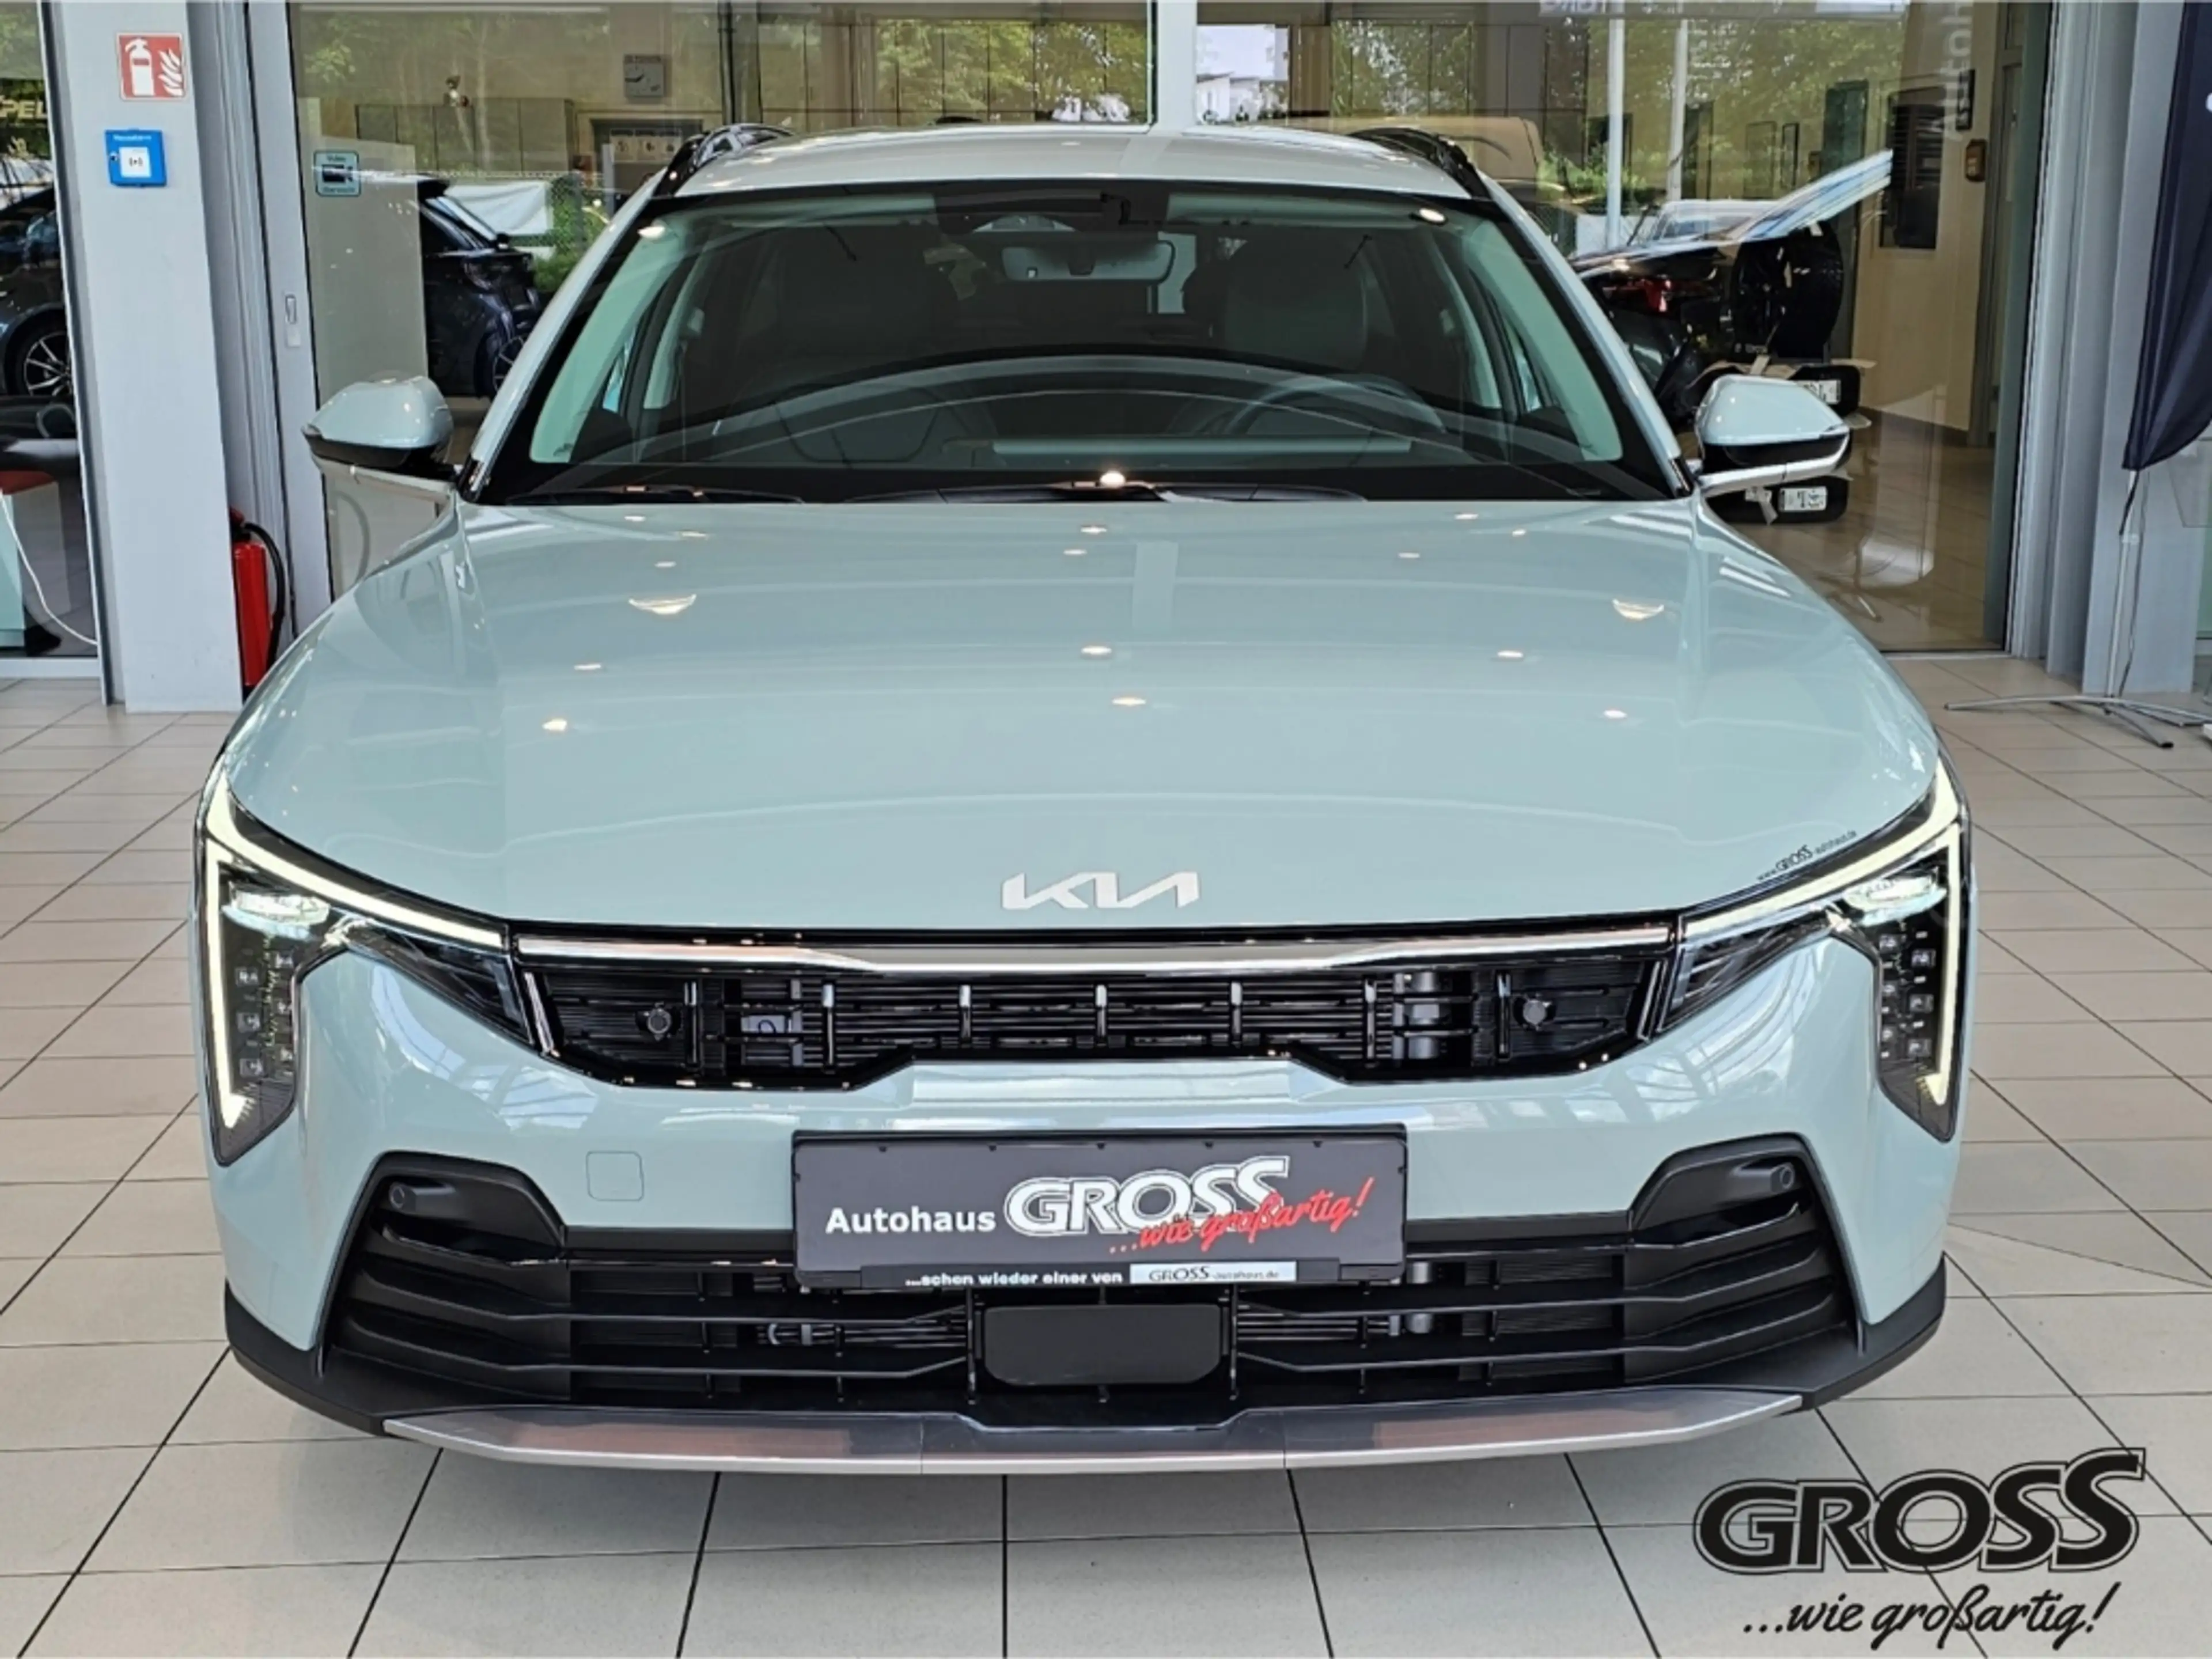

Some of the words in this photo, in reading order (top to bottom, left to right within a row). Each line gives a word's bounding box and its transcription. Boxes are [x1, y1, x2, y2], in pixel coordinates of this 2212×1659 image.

[0, 95, 48, 120] PEL
[1002, 871, 1200, 910] KIA
[825, 1205, 997, 1234] Autohaus
[1003, 1155, 1290, 1236] GROSS
[1198, 1176, 1375, 1252] großartig!
[904, 1271, 974, 1286] ...schon
[978, 1271, 1038, 1285] wieder
[1042, 1270, 1087, 1284] einer
[1091, 1272, 1124, 1284] von
